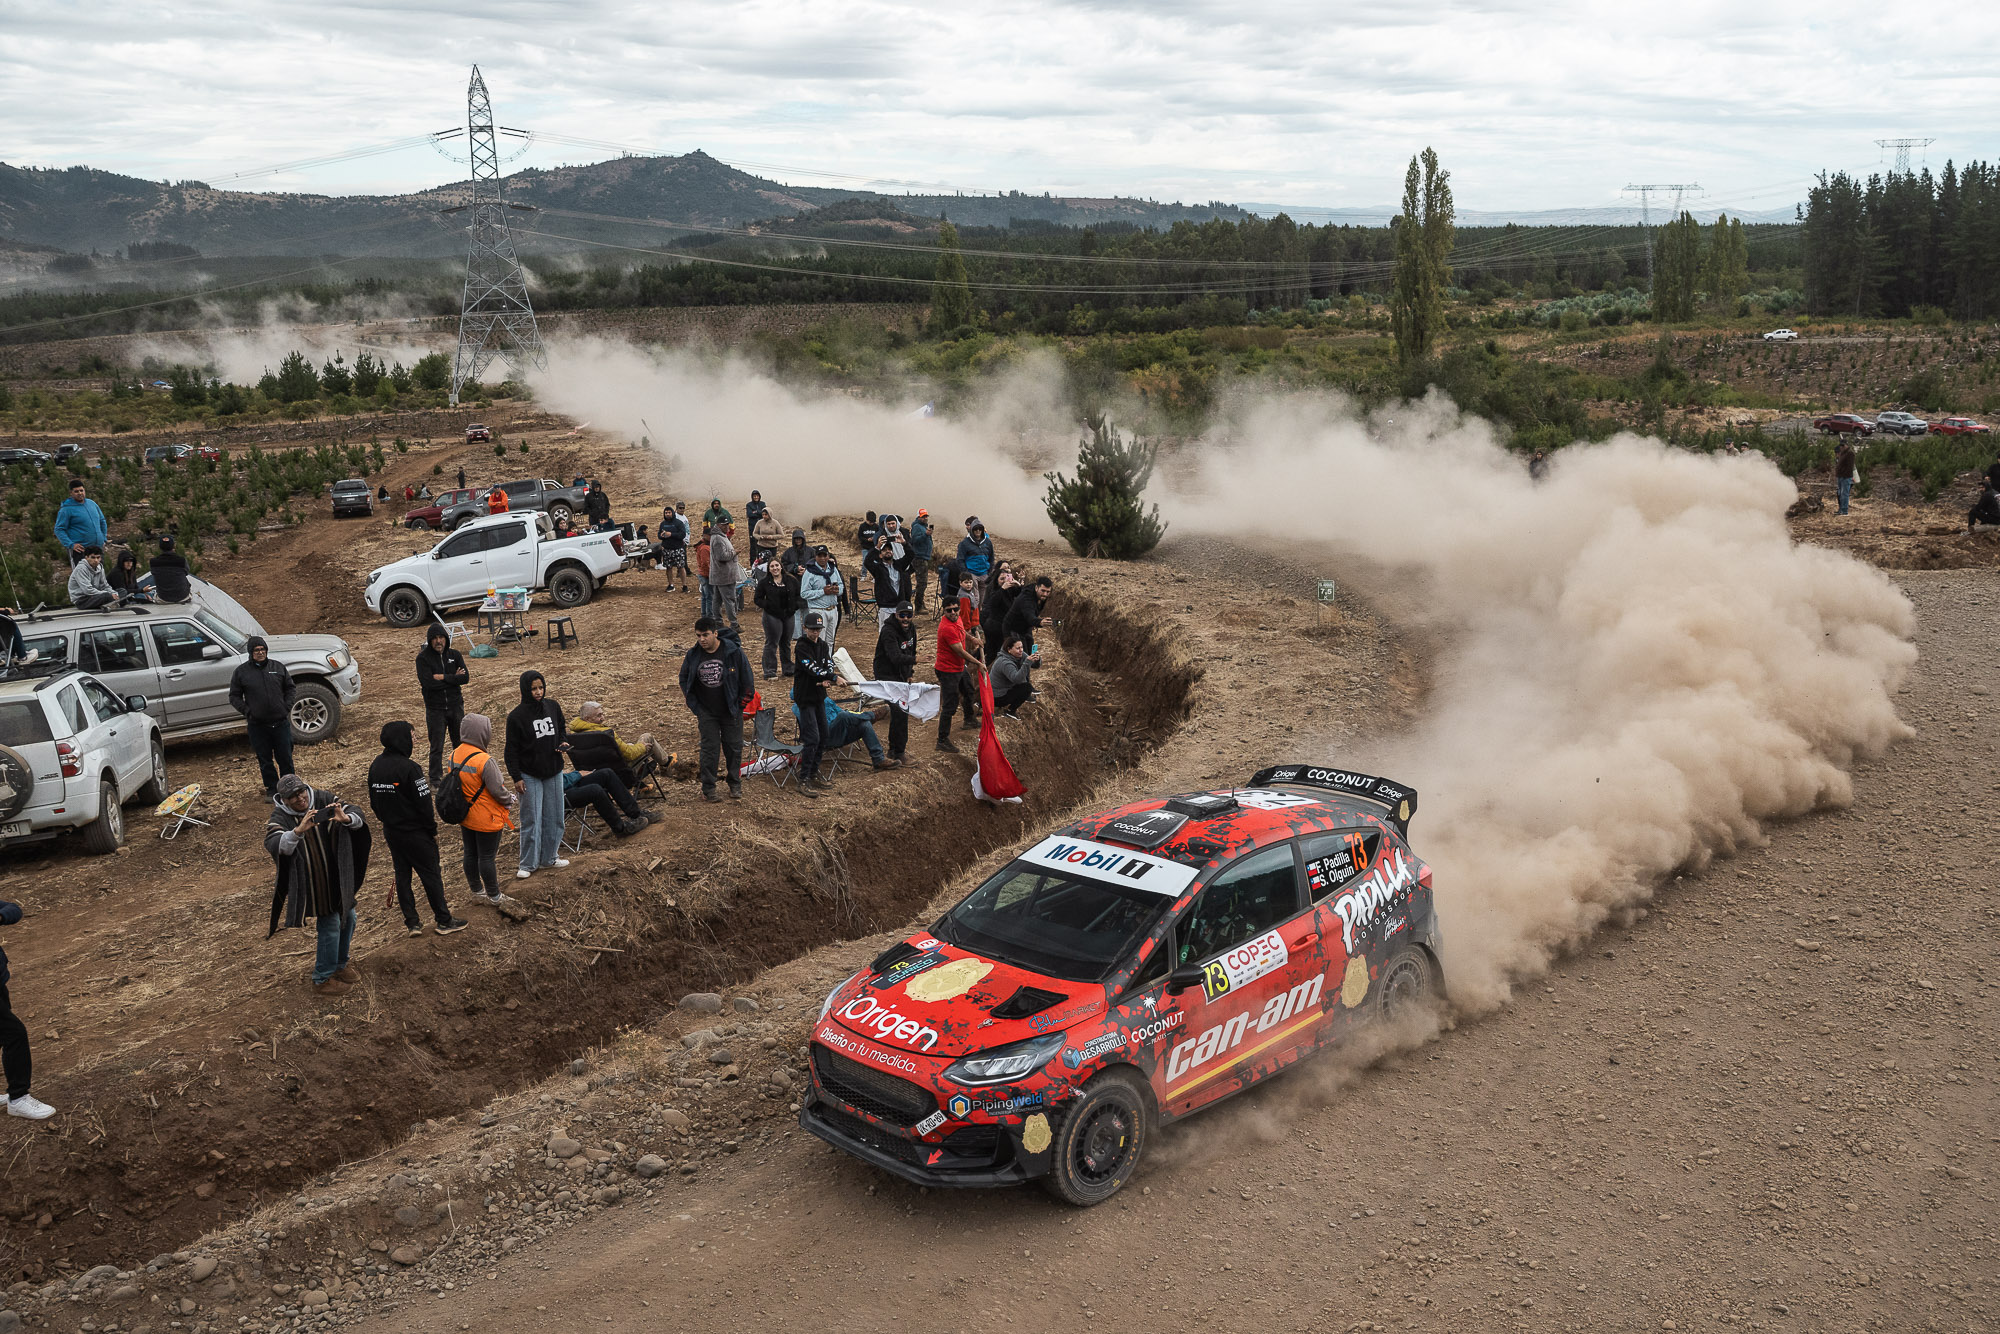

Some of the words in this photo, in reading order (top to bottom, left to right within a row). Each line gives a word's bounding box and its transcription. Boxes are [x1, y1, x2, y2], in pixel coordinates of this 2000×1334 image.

[1307, 769, 1375, 789] COCONUT
[1113, 822, 1157, 835] COCONUT
[1044, 844, 1125, 871] Mobil
[1315, 861, 1324, 874] F.
[1323, 851, 1350, 871] Padilla
[1343, 831, 1368, 871] 73
[1319, 874, 1329, 887] S.
[1334, 846, 1412, 954] PADILLA
[1353, 880, 1417, 946] MOTORSPORT
[889, 961, 909, 971] 73
[1204, 962, 1229, 997] 73
[1228, 935, 1280, 970] COPEC
[835, 994, 938, 1052] iOrigen
[1131, 1011, 1185, 1043] COCONUT
[1166, 973, 1324, 1083] can-am
[820, 1027, 848, 1048] Diseño
[848, 1042, 857, 1051] a
[857, 1042, 869, 1057] tu
[868, 1049, 917, 1074] medida.
[1080, 1035, 1127, 1061] DESARROLLO
[972, 1092, 1043, 1112] PipingWeld
